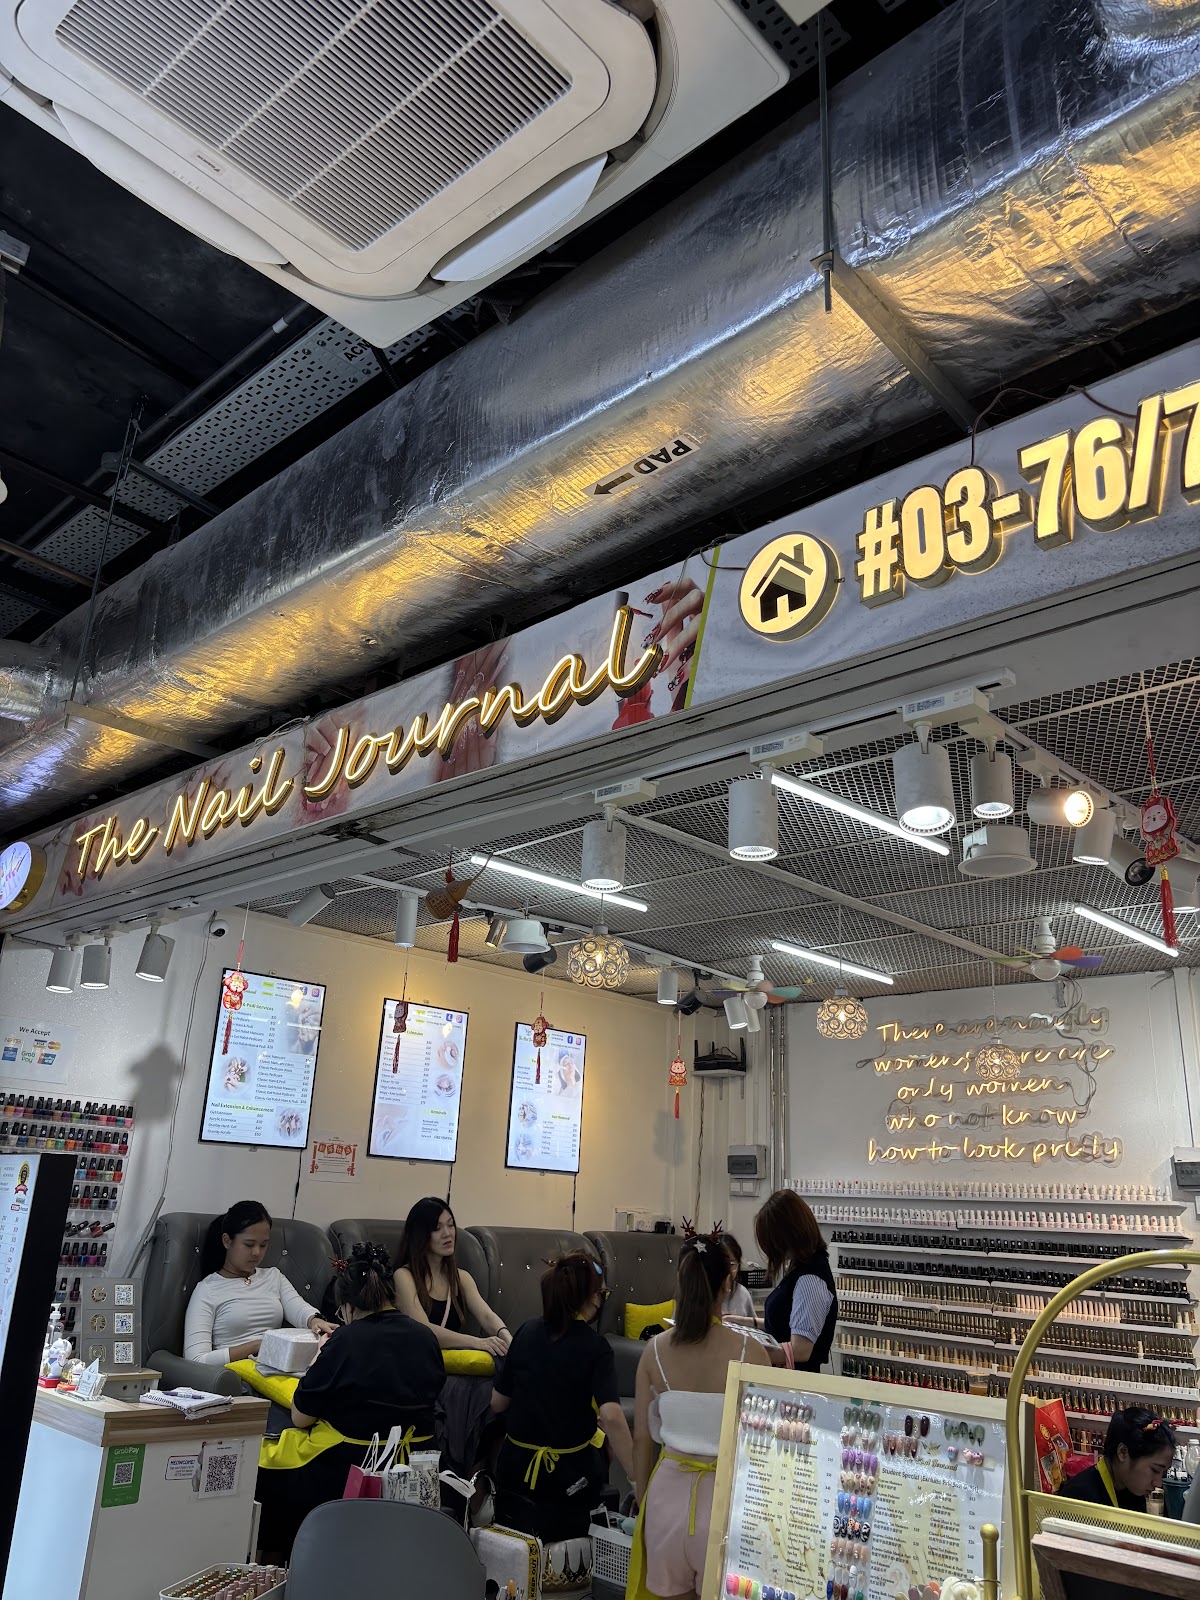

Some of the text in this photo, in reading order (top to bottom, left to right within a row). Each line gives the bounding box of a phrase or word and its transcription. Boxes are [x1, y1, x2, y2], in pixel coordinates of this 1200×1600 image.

[633, 439, 693, 475] PAD
[76, 605, 664, 882] The Nail Journal
[19, 1026, 51, 1037] We Accept
[877, 1021, 944, 1043] There
[1057, 1043, 1113, 1062] are
[897, 1075, 1068, 1102] only women
[1001, 1103, 1080, 1127] know
[867, 1137, 926, 1162] how
[927, 1140, 958, 1161] to
[962, 1135, 1026, 1159] look
[882, 1468, 901, 1477] Student
[902, 1472, 920, 1482] Special
